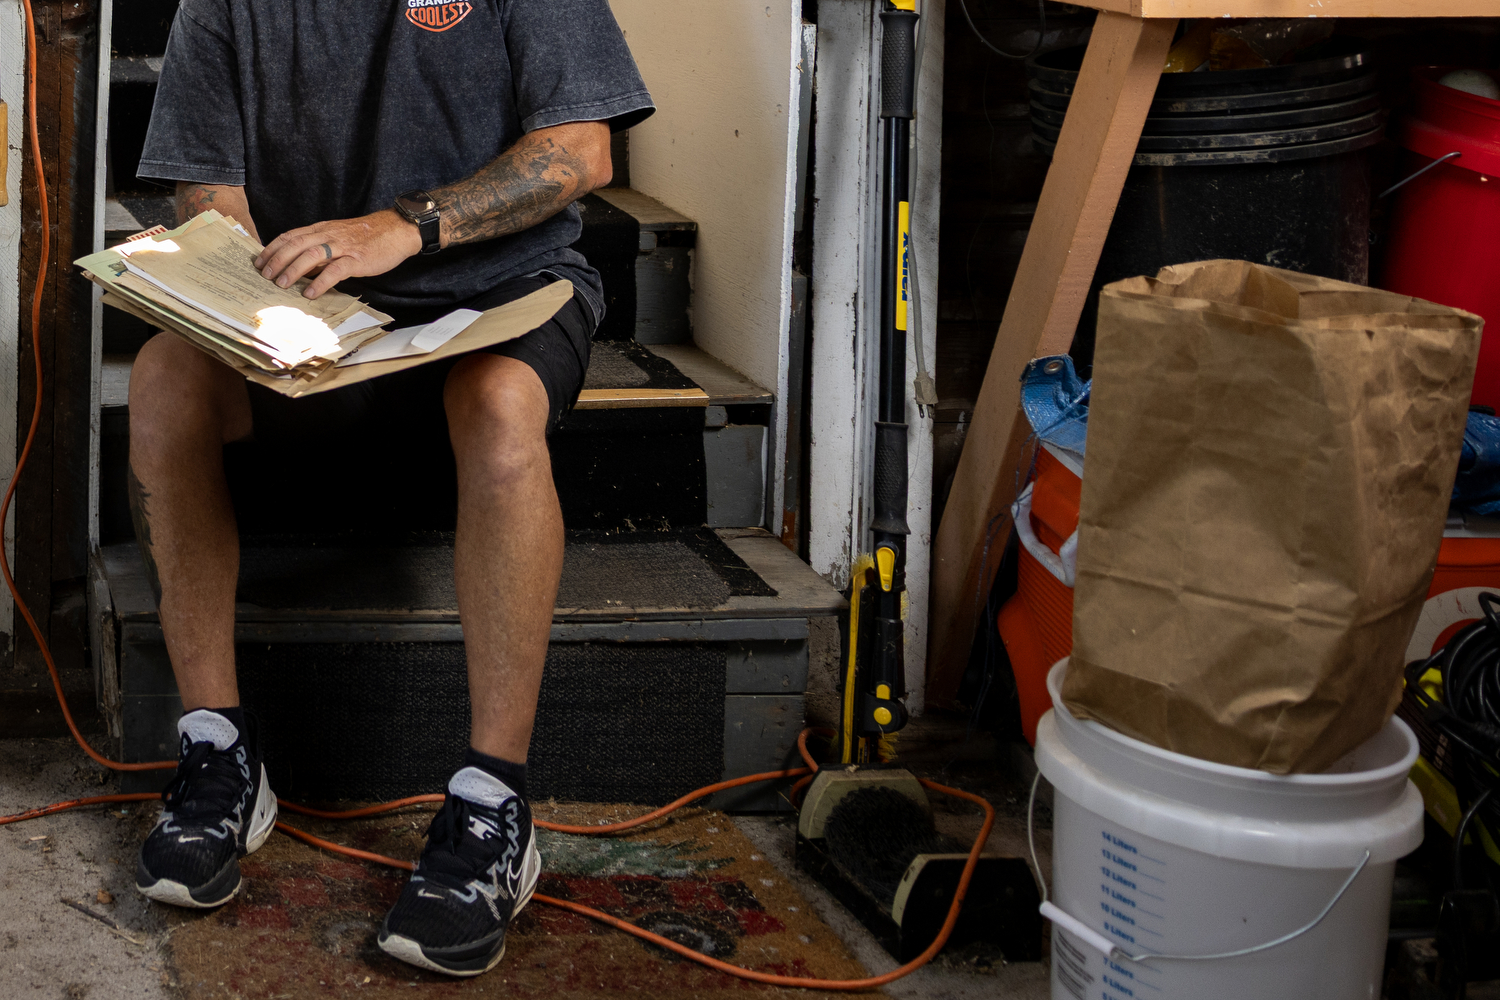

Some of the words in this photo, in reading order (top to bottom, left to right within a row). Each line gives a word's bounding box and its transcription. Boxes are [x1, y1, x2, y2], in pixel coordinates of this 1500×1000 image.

[411, 2, 464, 26] COOLEST
[1102, 831, 1111, 842] 14
[1113, 837, 1138, 854] Liters
[1102, 849, 1111, 860] 13
[1113, 855, 1137, 872] Liters
[1102, 866, 1110, 877] 12
[1112, 872, 1137, 890] Liters
[1101, 884, 1110, 894] 11
[1112, 890, 1136, 908] Liters
[1101, 902, 1110, 912] 10
[1111, 908, 1135, 925] Liters
[1111, 925, 1135, 943] Liters
[1110, 960, 1134, 979] Liters
[1110, 978, 1133, 997] Liters
